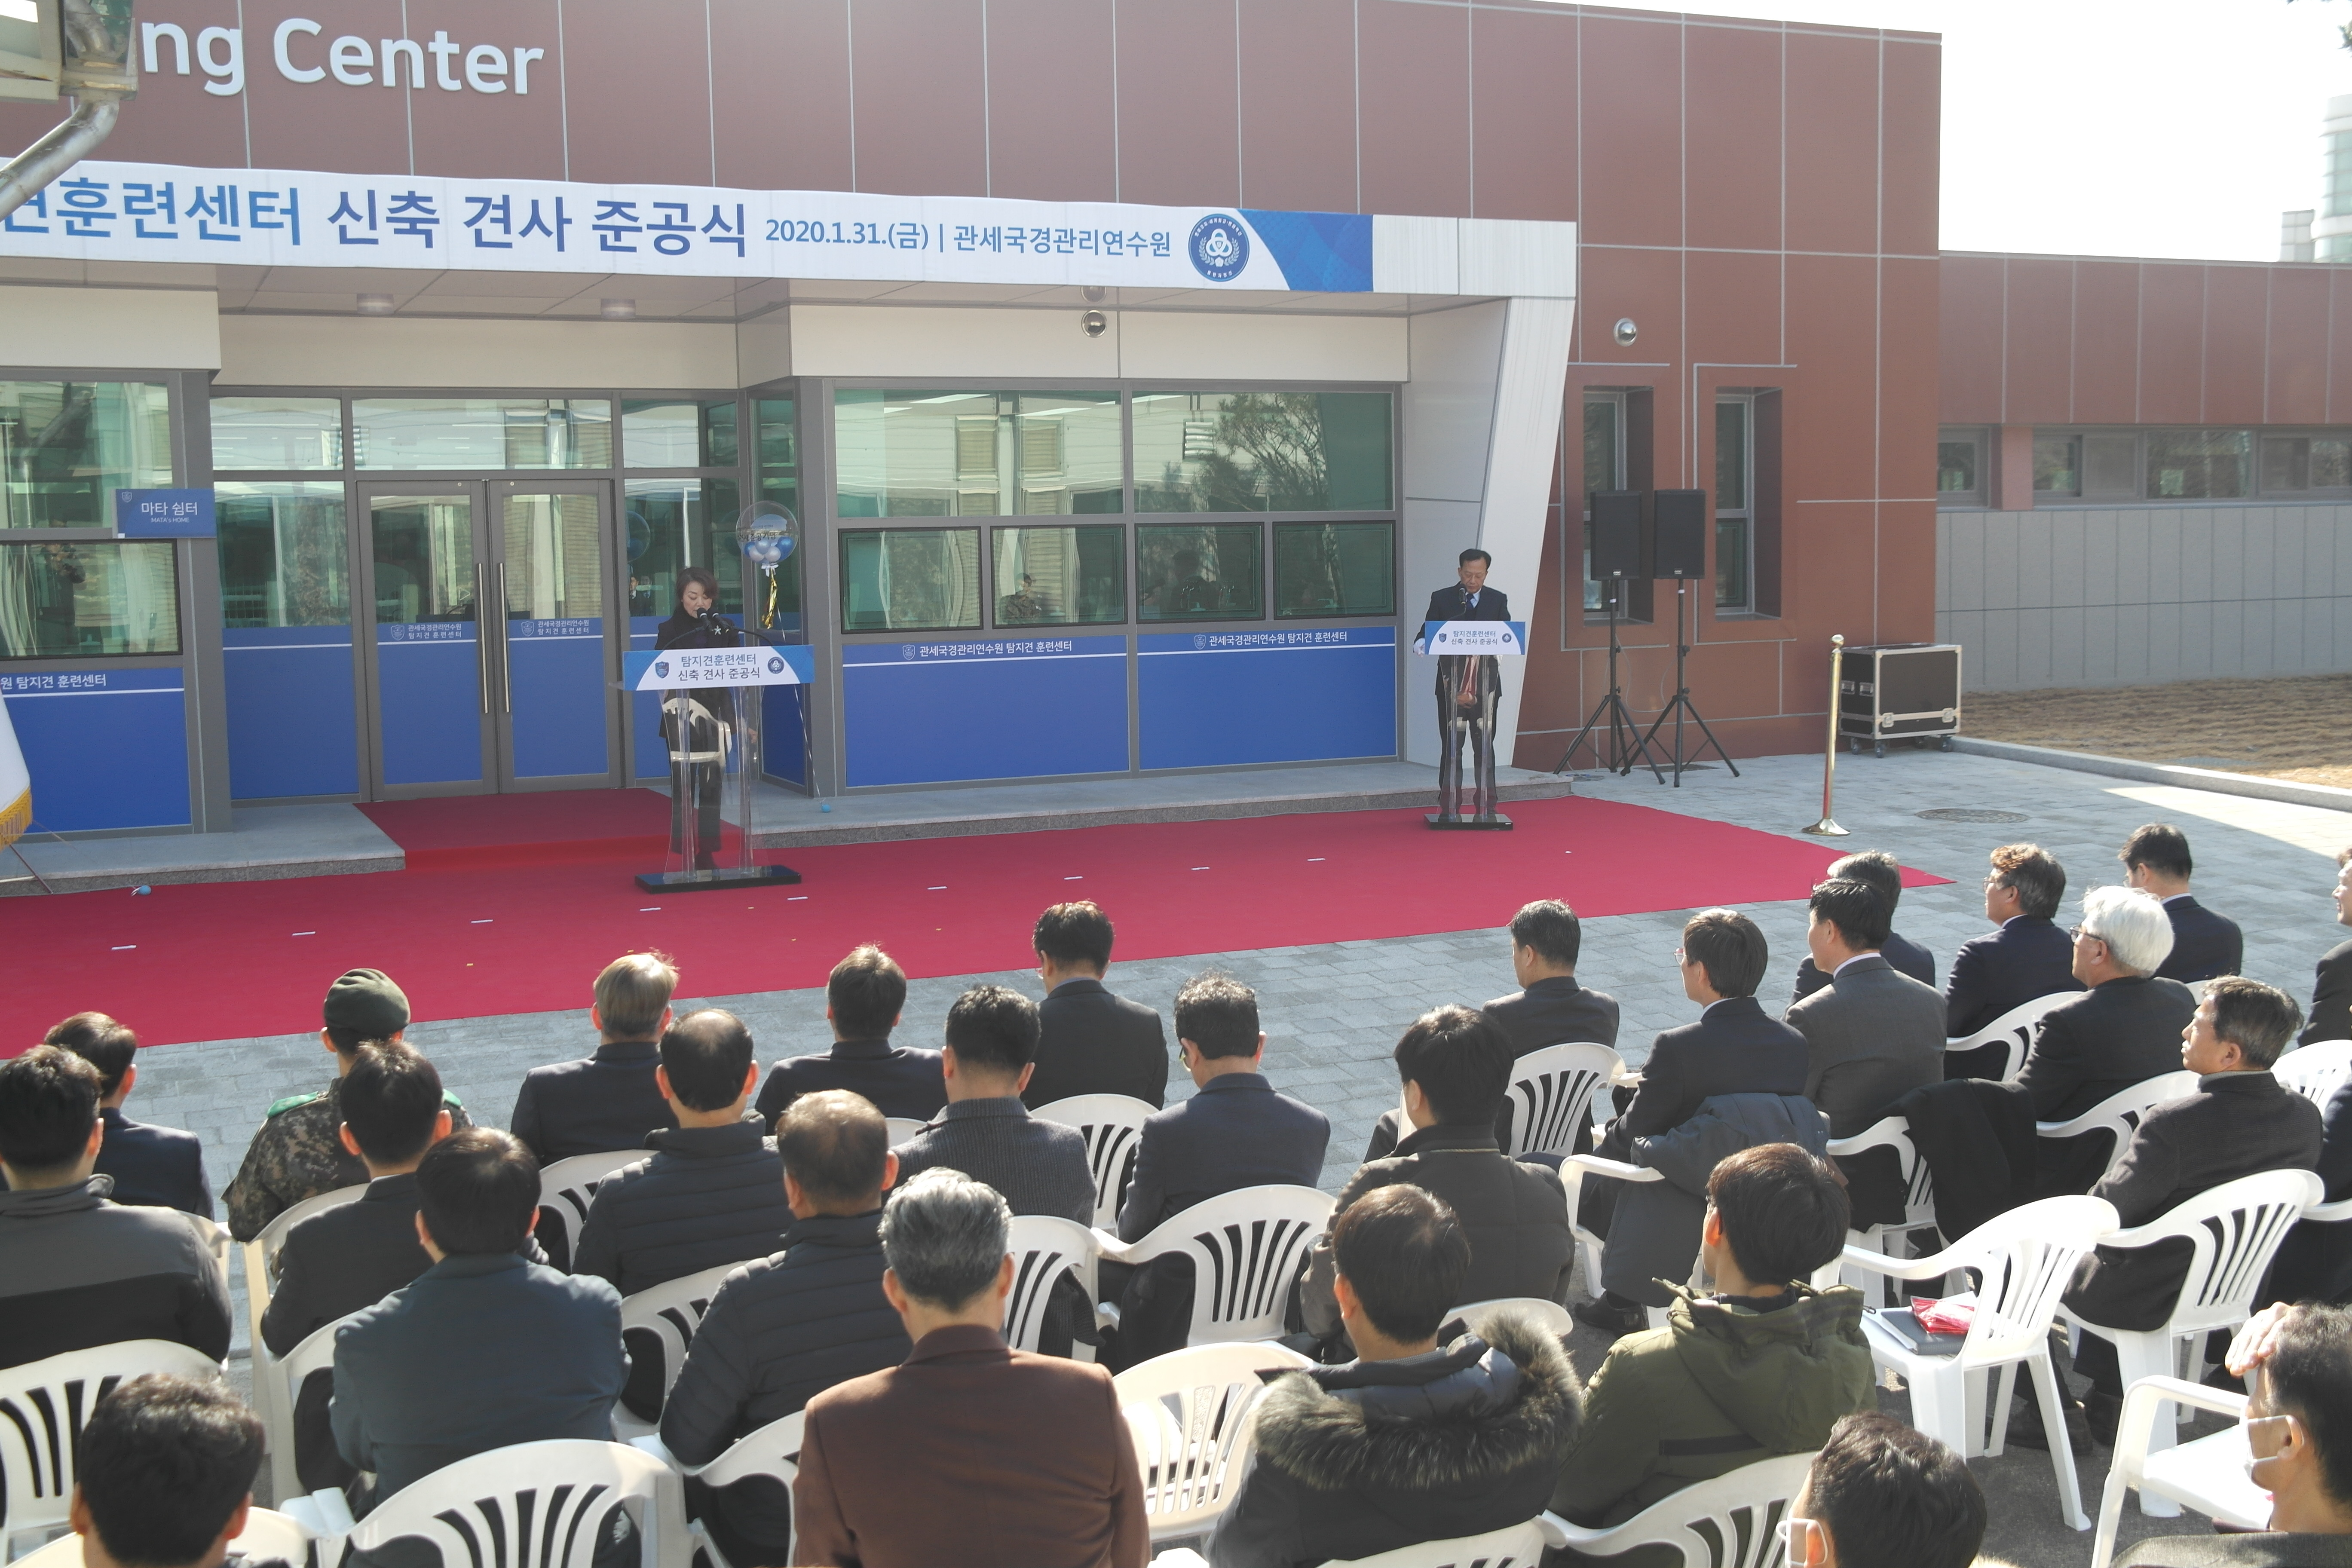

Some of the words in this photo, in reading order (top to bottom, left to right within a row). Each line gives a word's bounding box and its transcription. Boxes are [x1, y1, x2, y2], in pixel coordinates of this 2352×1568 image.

[273, 18, 544, 95] Center
[328, 189, 440, 248] 신축
[463, 194, 573, 252] 견사
[592, 200, 745, 257] 준공식
[766, 219, 929, 250] 2020.1.31.(금)
[953, 224, 1171, 257] 관세국경관리연수원
[141, 502, 168, 515] 마타
[172, 502, 198, 516] 쉼터
[1209, 633, 1285, 646] 관세국경관리연수원
[1288, 632, 1312, 643] 탐지견
[1314, 631, 1347, 643] 훈련센터
[919, 643, 1004, 657] 관세국경관리연수원
[1006, 642, 1033, 654] 탐지견
[1036, 640, 1072, 652] 훈련센터
[681, 653, 756, 667] 탐지견훈련센터
[17, 675, 54, 689] 탐지견
[58, 674, 107, 688] 훈련센터
[678, 669, 699, 681] 신축
[703, 668, 725, 680] 견사
[728, 667, 760, 679] 준공식
